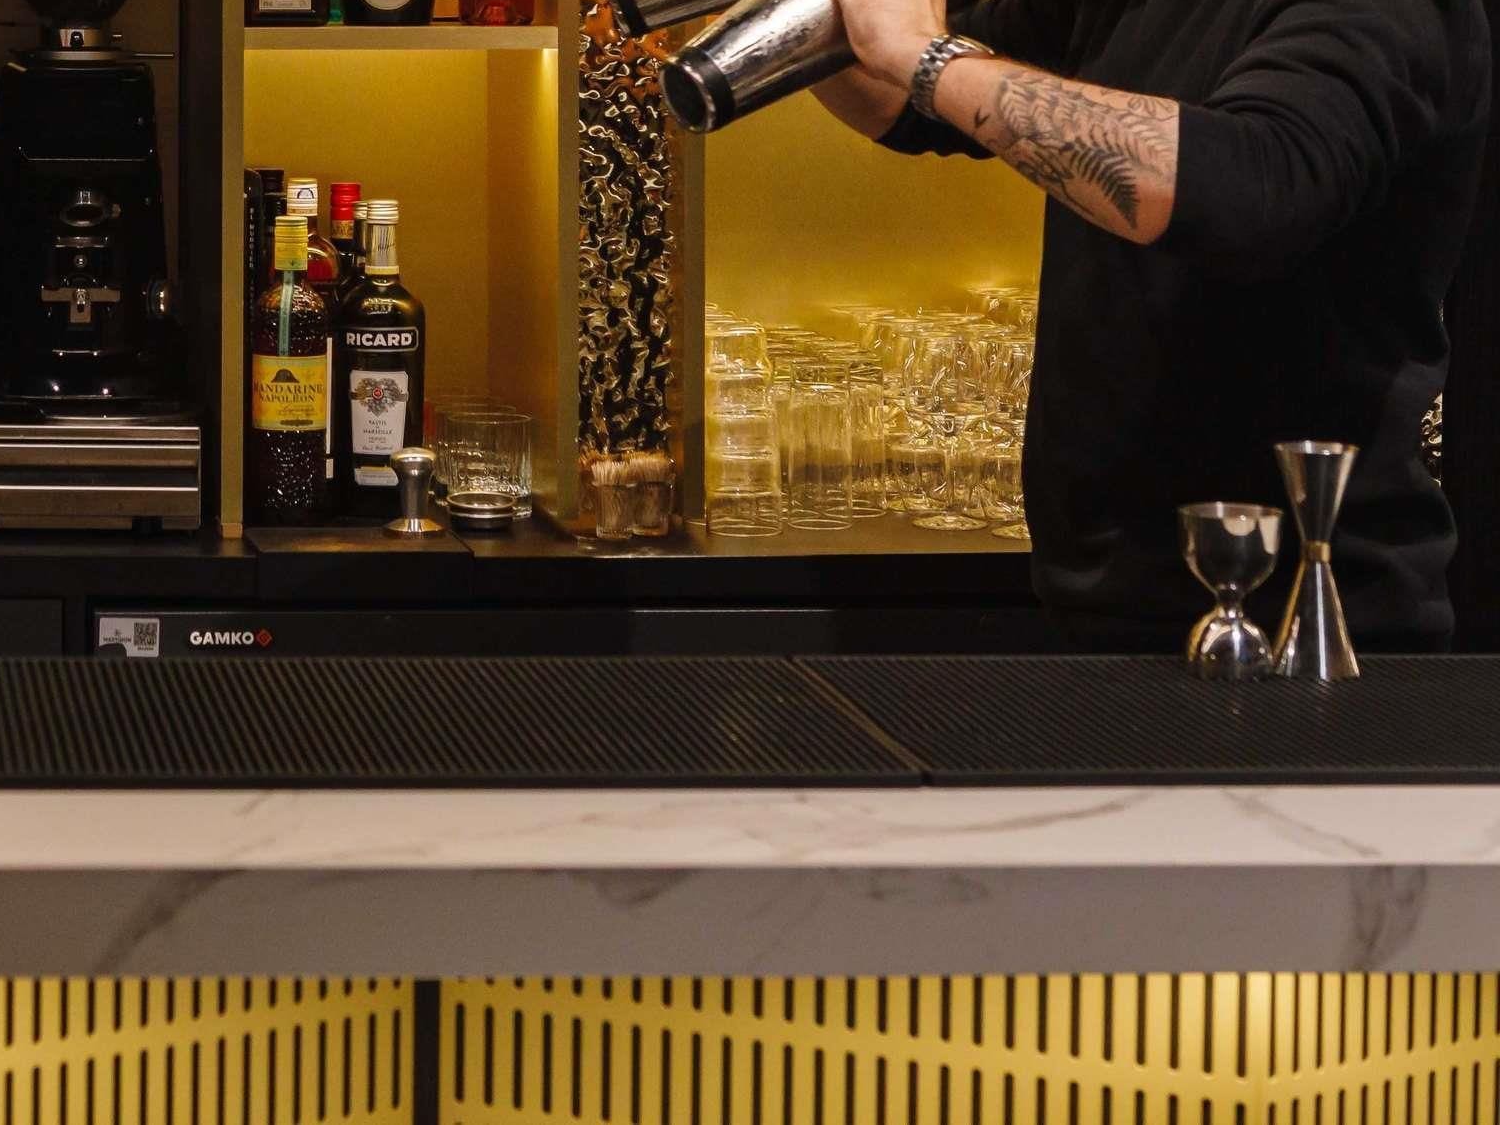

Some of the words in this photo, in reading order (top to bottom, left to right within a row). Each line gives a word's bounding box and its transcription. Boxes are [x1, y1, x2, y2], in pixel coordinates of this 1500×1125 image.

[346, 332, 413, 347] RICARD
[254, 379, 325, 394] MANDARINE
[189, 631, 254, 646] GAMKO
